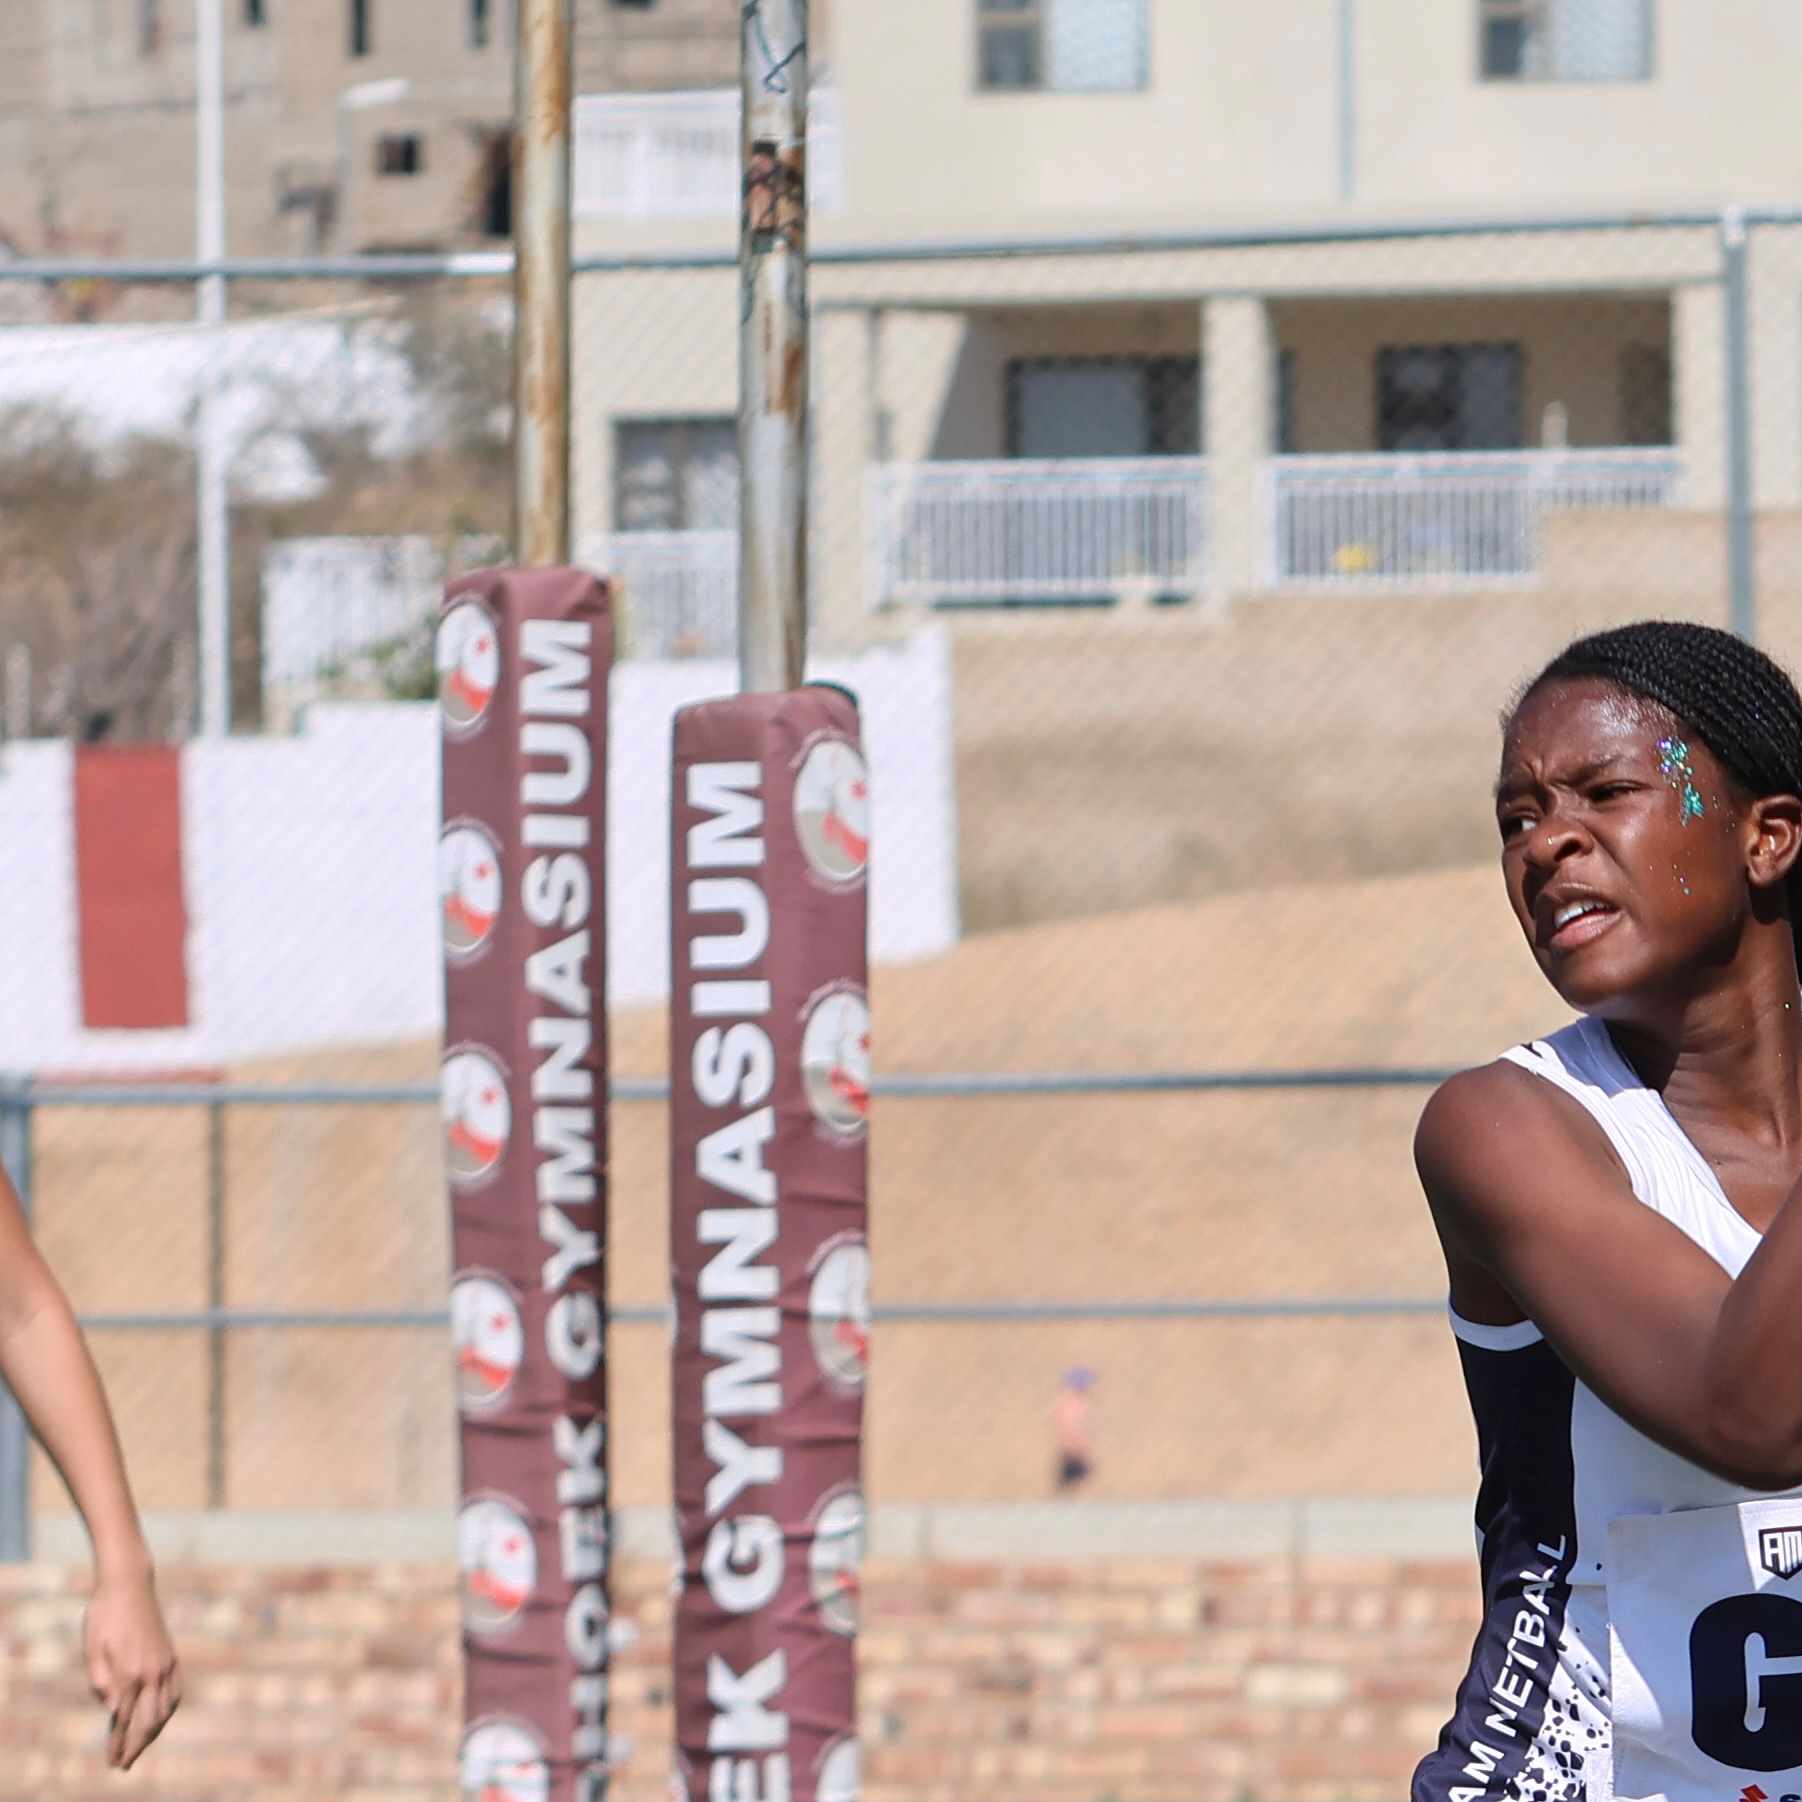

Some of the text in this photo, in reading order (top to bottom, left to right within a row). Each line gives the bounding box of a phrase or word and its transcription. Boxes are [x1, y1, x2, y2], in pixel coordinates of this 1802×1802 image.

[519, 619, 602, 1379] GYMNASIUM
[686, 759, 786, 1615] GYMNASIUM
[1484, 1533, 1568, 1739] NETBALL
